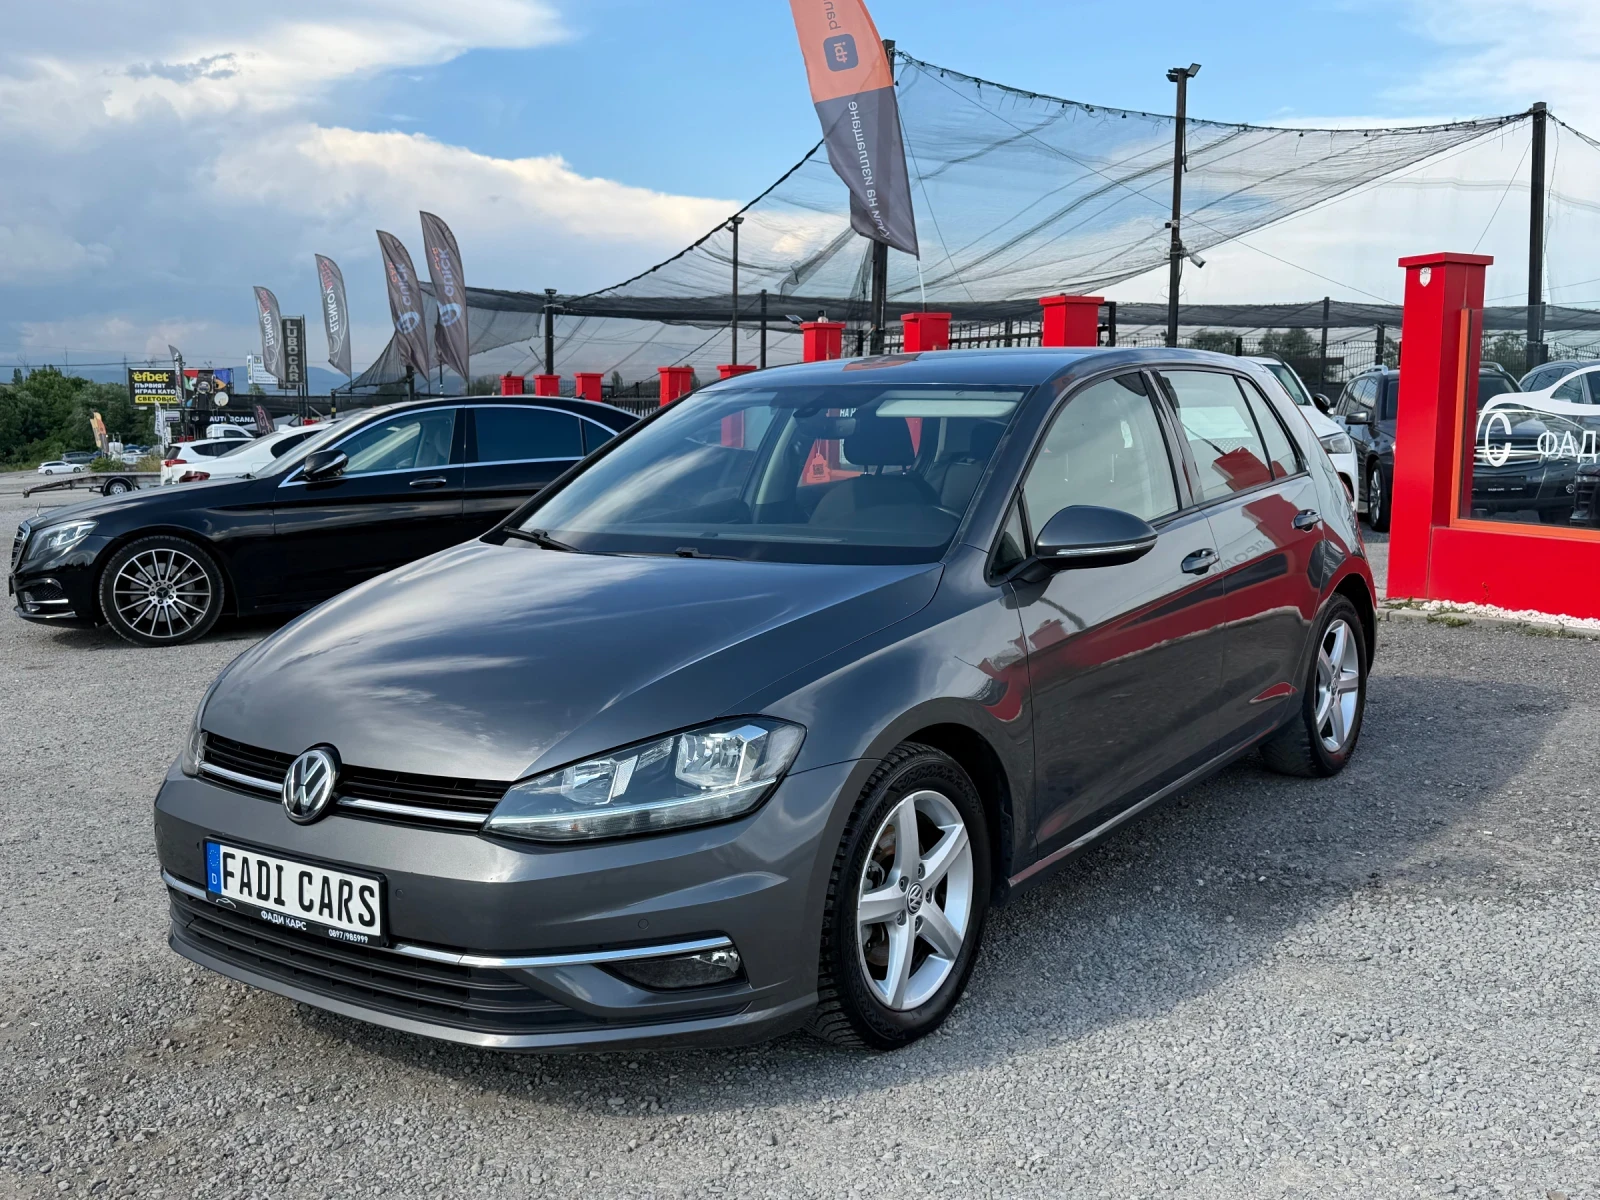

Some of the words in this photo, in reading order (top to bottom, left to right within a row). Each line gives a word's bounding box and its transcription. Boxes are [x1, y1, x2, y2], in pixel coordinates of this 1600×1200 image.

[286, 320, 299, 355] LUBO
[133, 371, 169, 382] efbet
[288, 356, 300, 382] CAR
[211, 873, 218, 885] D
[222, 851, 286, 907] FADI
[298, 870, 376, 927] CARS
[260, 910, 285, 925] ФАДИ
[285, 917, 307, 931] КАРС
